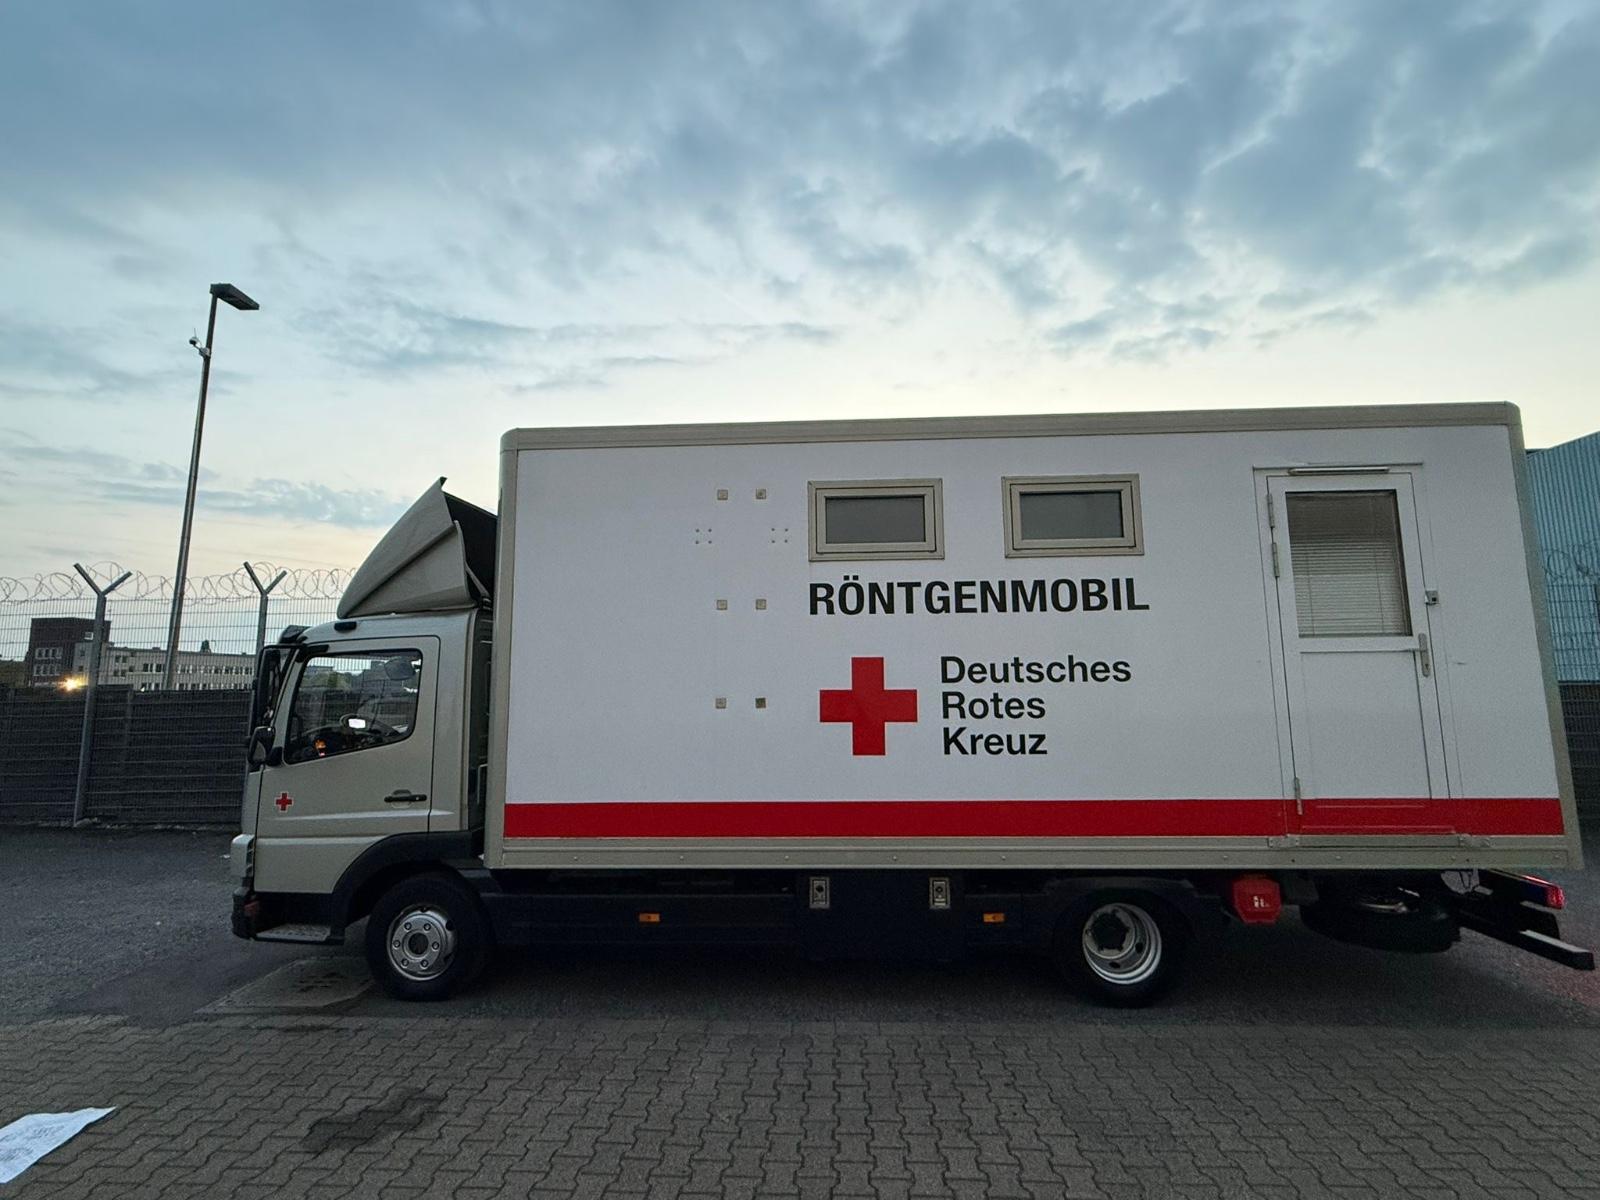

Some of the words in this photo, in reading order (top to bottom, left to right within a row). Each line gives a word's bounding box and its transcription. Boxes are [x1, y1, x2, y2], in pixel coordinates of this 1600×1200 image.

[809, 575, 1150, 615] RÖNTGENMOBIL
[940, 655, 1132, 684] Deutsches
[941, 691, 1046, 720] Rotes
[942, 727, 1048, 755] Kreuz
